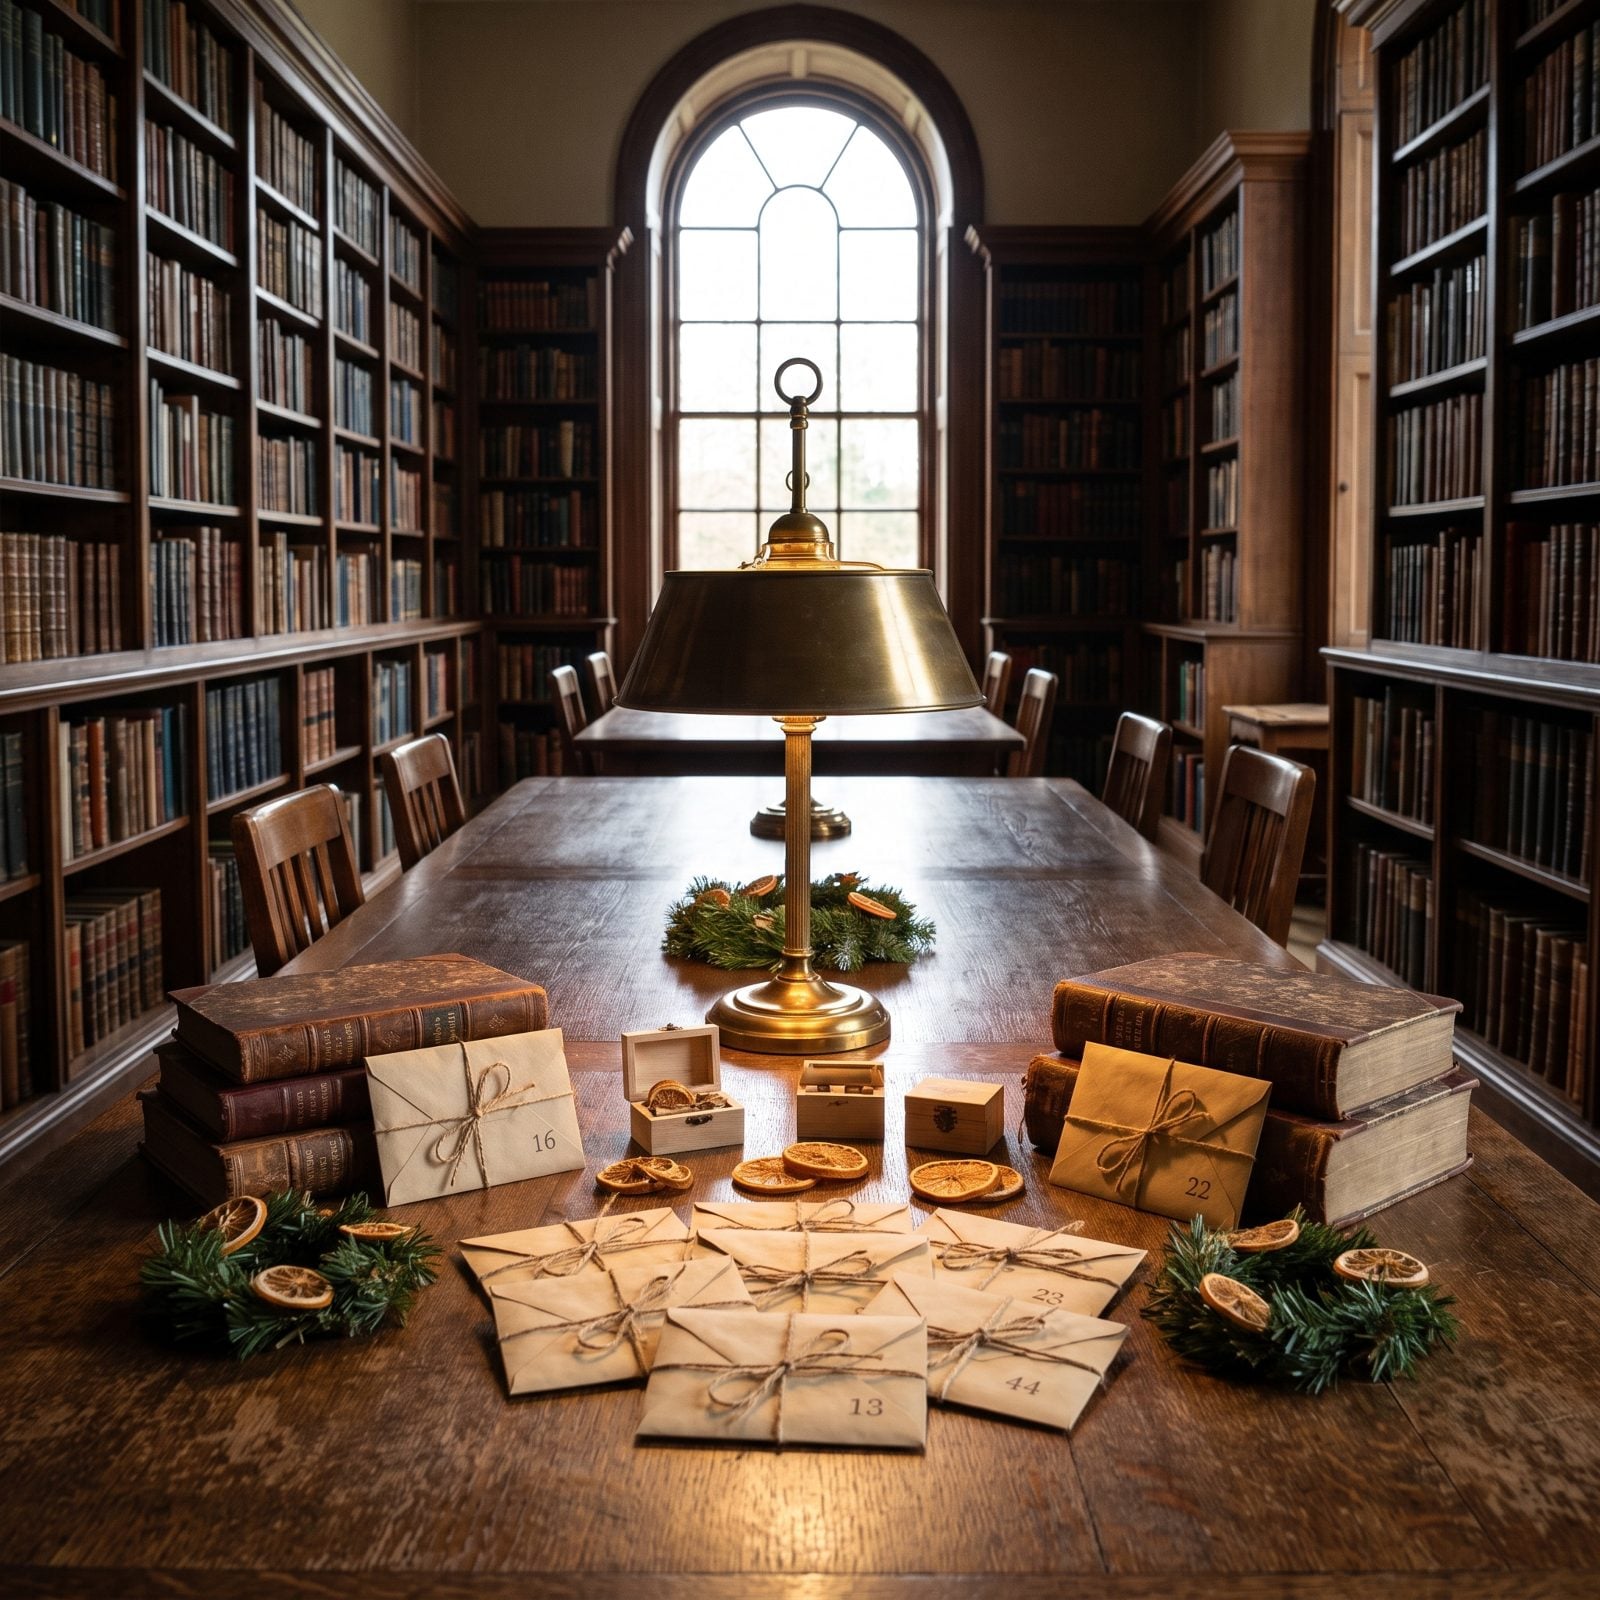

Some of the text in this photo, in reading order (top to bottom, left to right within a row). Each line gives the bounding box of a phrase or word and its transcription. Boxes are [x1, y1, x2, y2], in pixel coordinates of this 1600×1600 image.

[532, 1129, 556, 1153] 16
[1185, 1176, 1211, 1200] 22
[1031, 1288, 1064, 1306] 23
[1005, 1376, 1041, 1396] 44
[849, 1397, 883, 1417] 13
